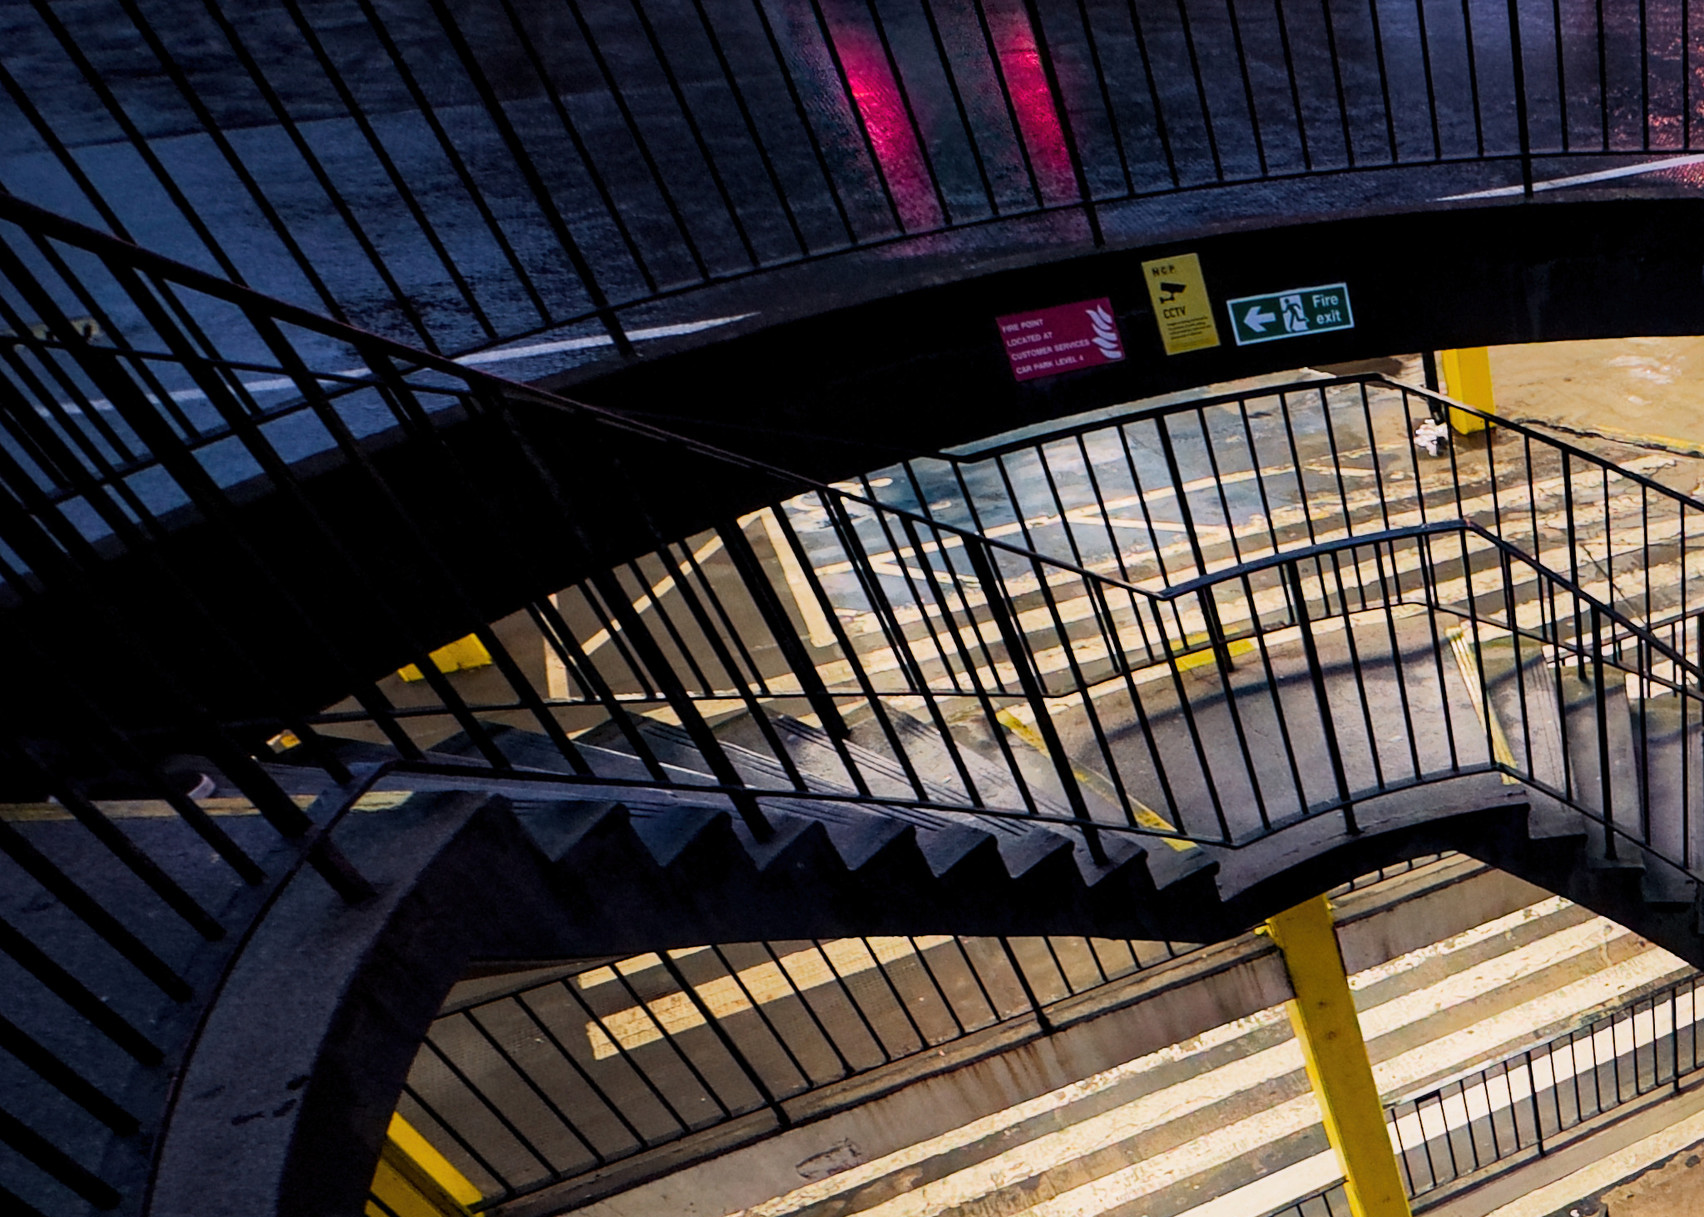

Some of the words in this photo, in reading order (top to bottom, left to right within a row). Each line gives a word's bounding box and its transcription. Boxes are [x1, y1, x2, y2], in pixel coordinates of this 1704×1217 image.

[1151, 264, 1176, 277] NCP
[1312, 293, 1339, 308] Fire
[1163, 306, 1186, 319] CCTV
[1316, 309, 1342, 325] exit
[1002, 324, 1019, 333] FIRE
[1021, 319, 1043, 329] POINT
[1007, 334, 1041, 346] LOCATED
[1043, 331, 1053, 339] AT
[1011, 346, 1053, 360] CUSTOMER
[1054, 339, 1090, 351] SERVICES
[1016, 364, 1032, 374] CAR
[1034, 360, 1054, 370] PARK
[1055, 356, 1077, 367] LEVEL
